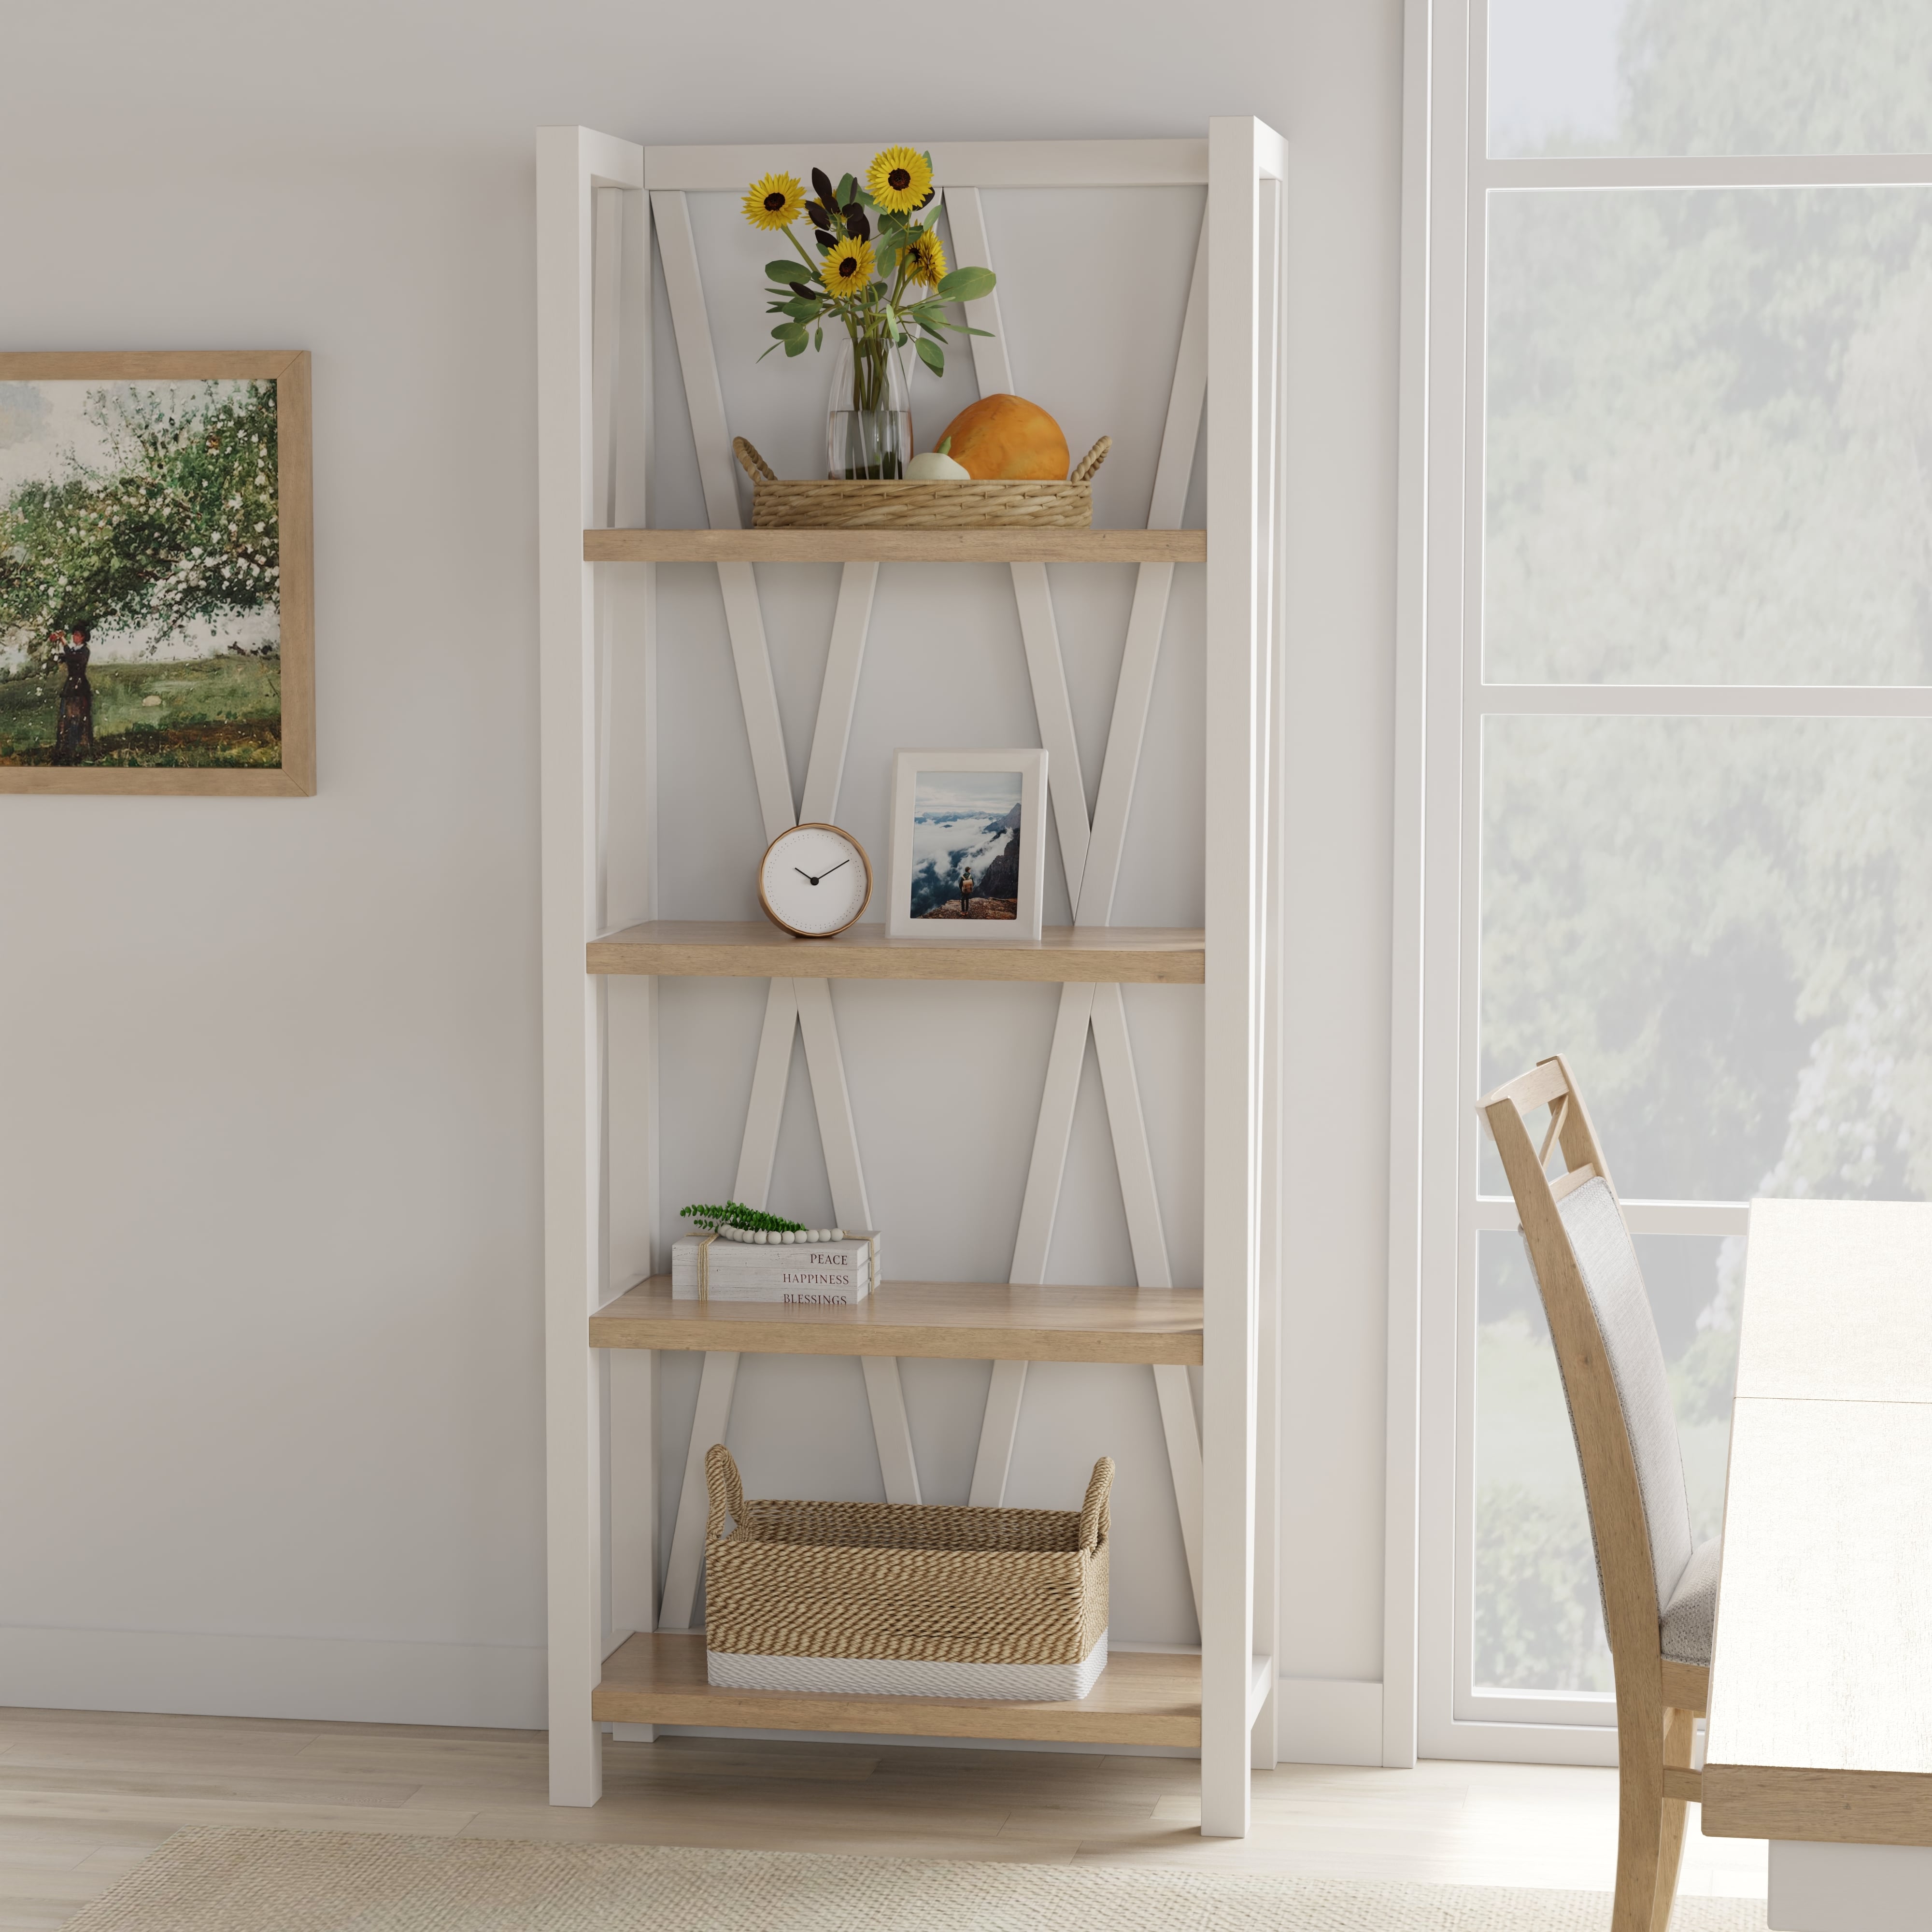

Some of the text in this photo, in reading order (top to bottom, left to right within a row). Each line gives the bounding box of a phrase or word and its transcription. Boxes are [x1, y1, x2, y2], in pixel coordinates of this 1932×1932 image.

[810, 1254, 848, 1265] PEACE
[783, 1274, 849, 1284] HAPPINESS
[783, 1294, 847, 1305] BLESSINGS
